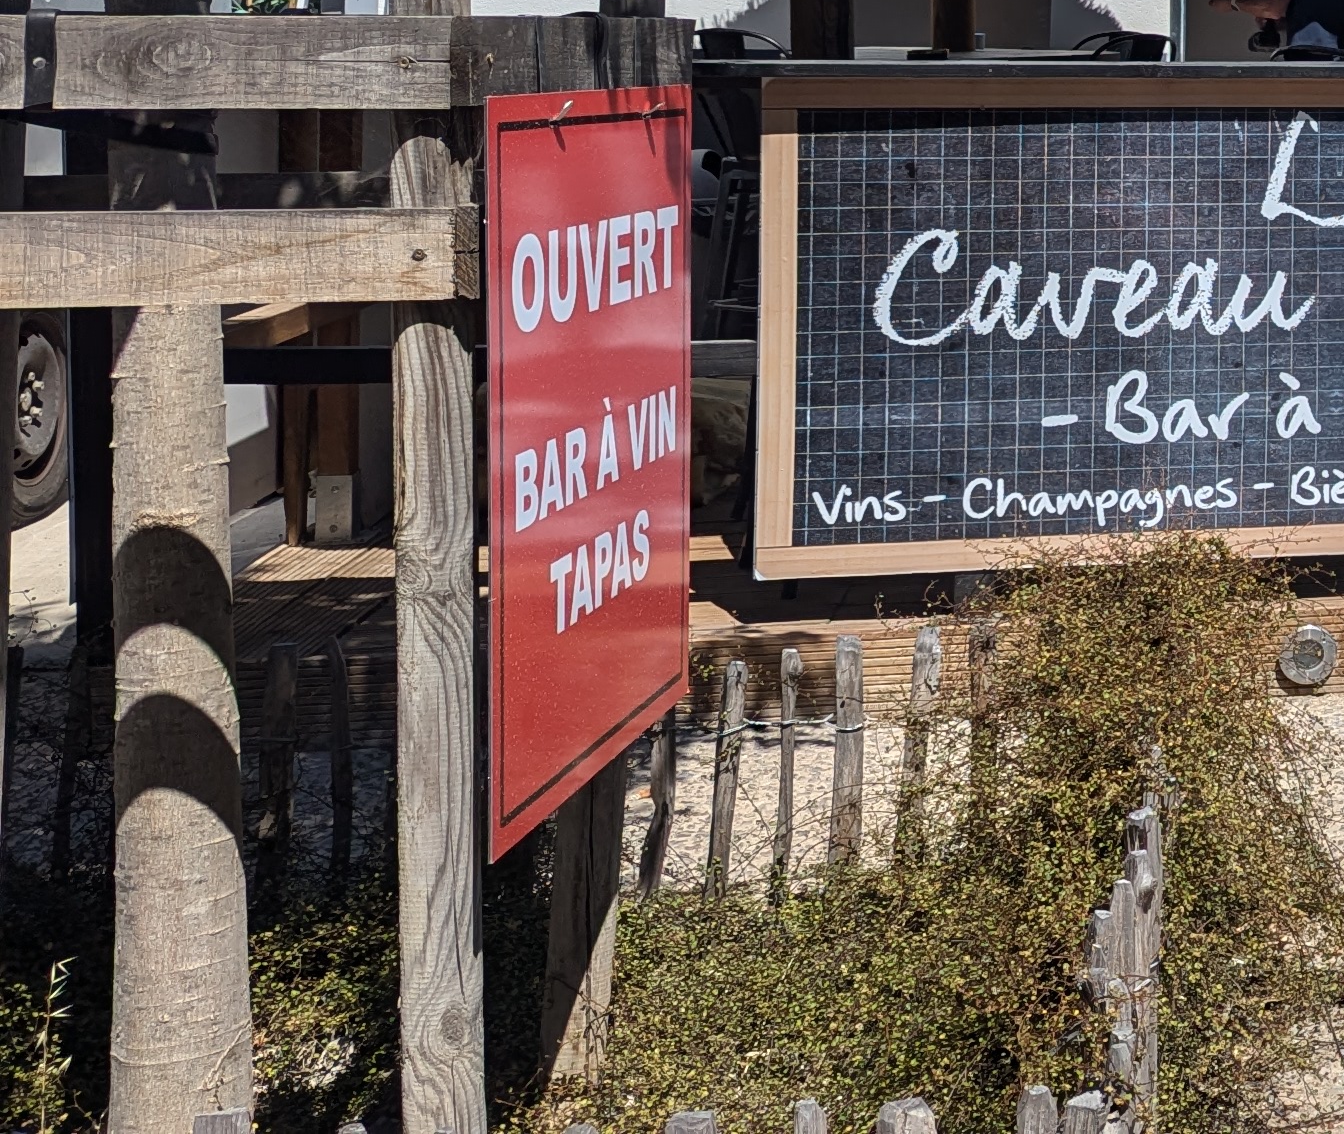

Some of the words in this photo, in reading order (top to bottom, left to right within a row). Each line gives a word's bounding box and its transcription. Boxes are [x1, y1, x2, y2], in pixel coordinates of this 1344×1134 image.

[511, 204, 679, 333] OUVERT
[873, 228, 1315, 346] Caveau
[514, 426, 587, 533] BAR
[596, 397, 620, 492] À
[627, 385, 677, 471] VIN
[1105, 369, 1250, 445] Bar
[1276, 371, 1321, 439] à
[811, 484, 908, 526] Vins
[962, 477, 1239, 527] Champagnes
[549, 509, 650, 635] TAPAS
